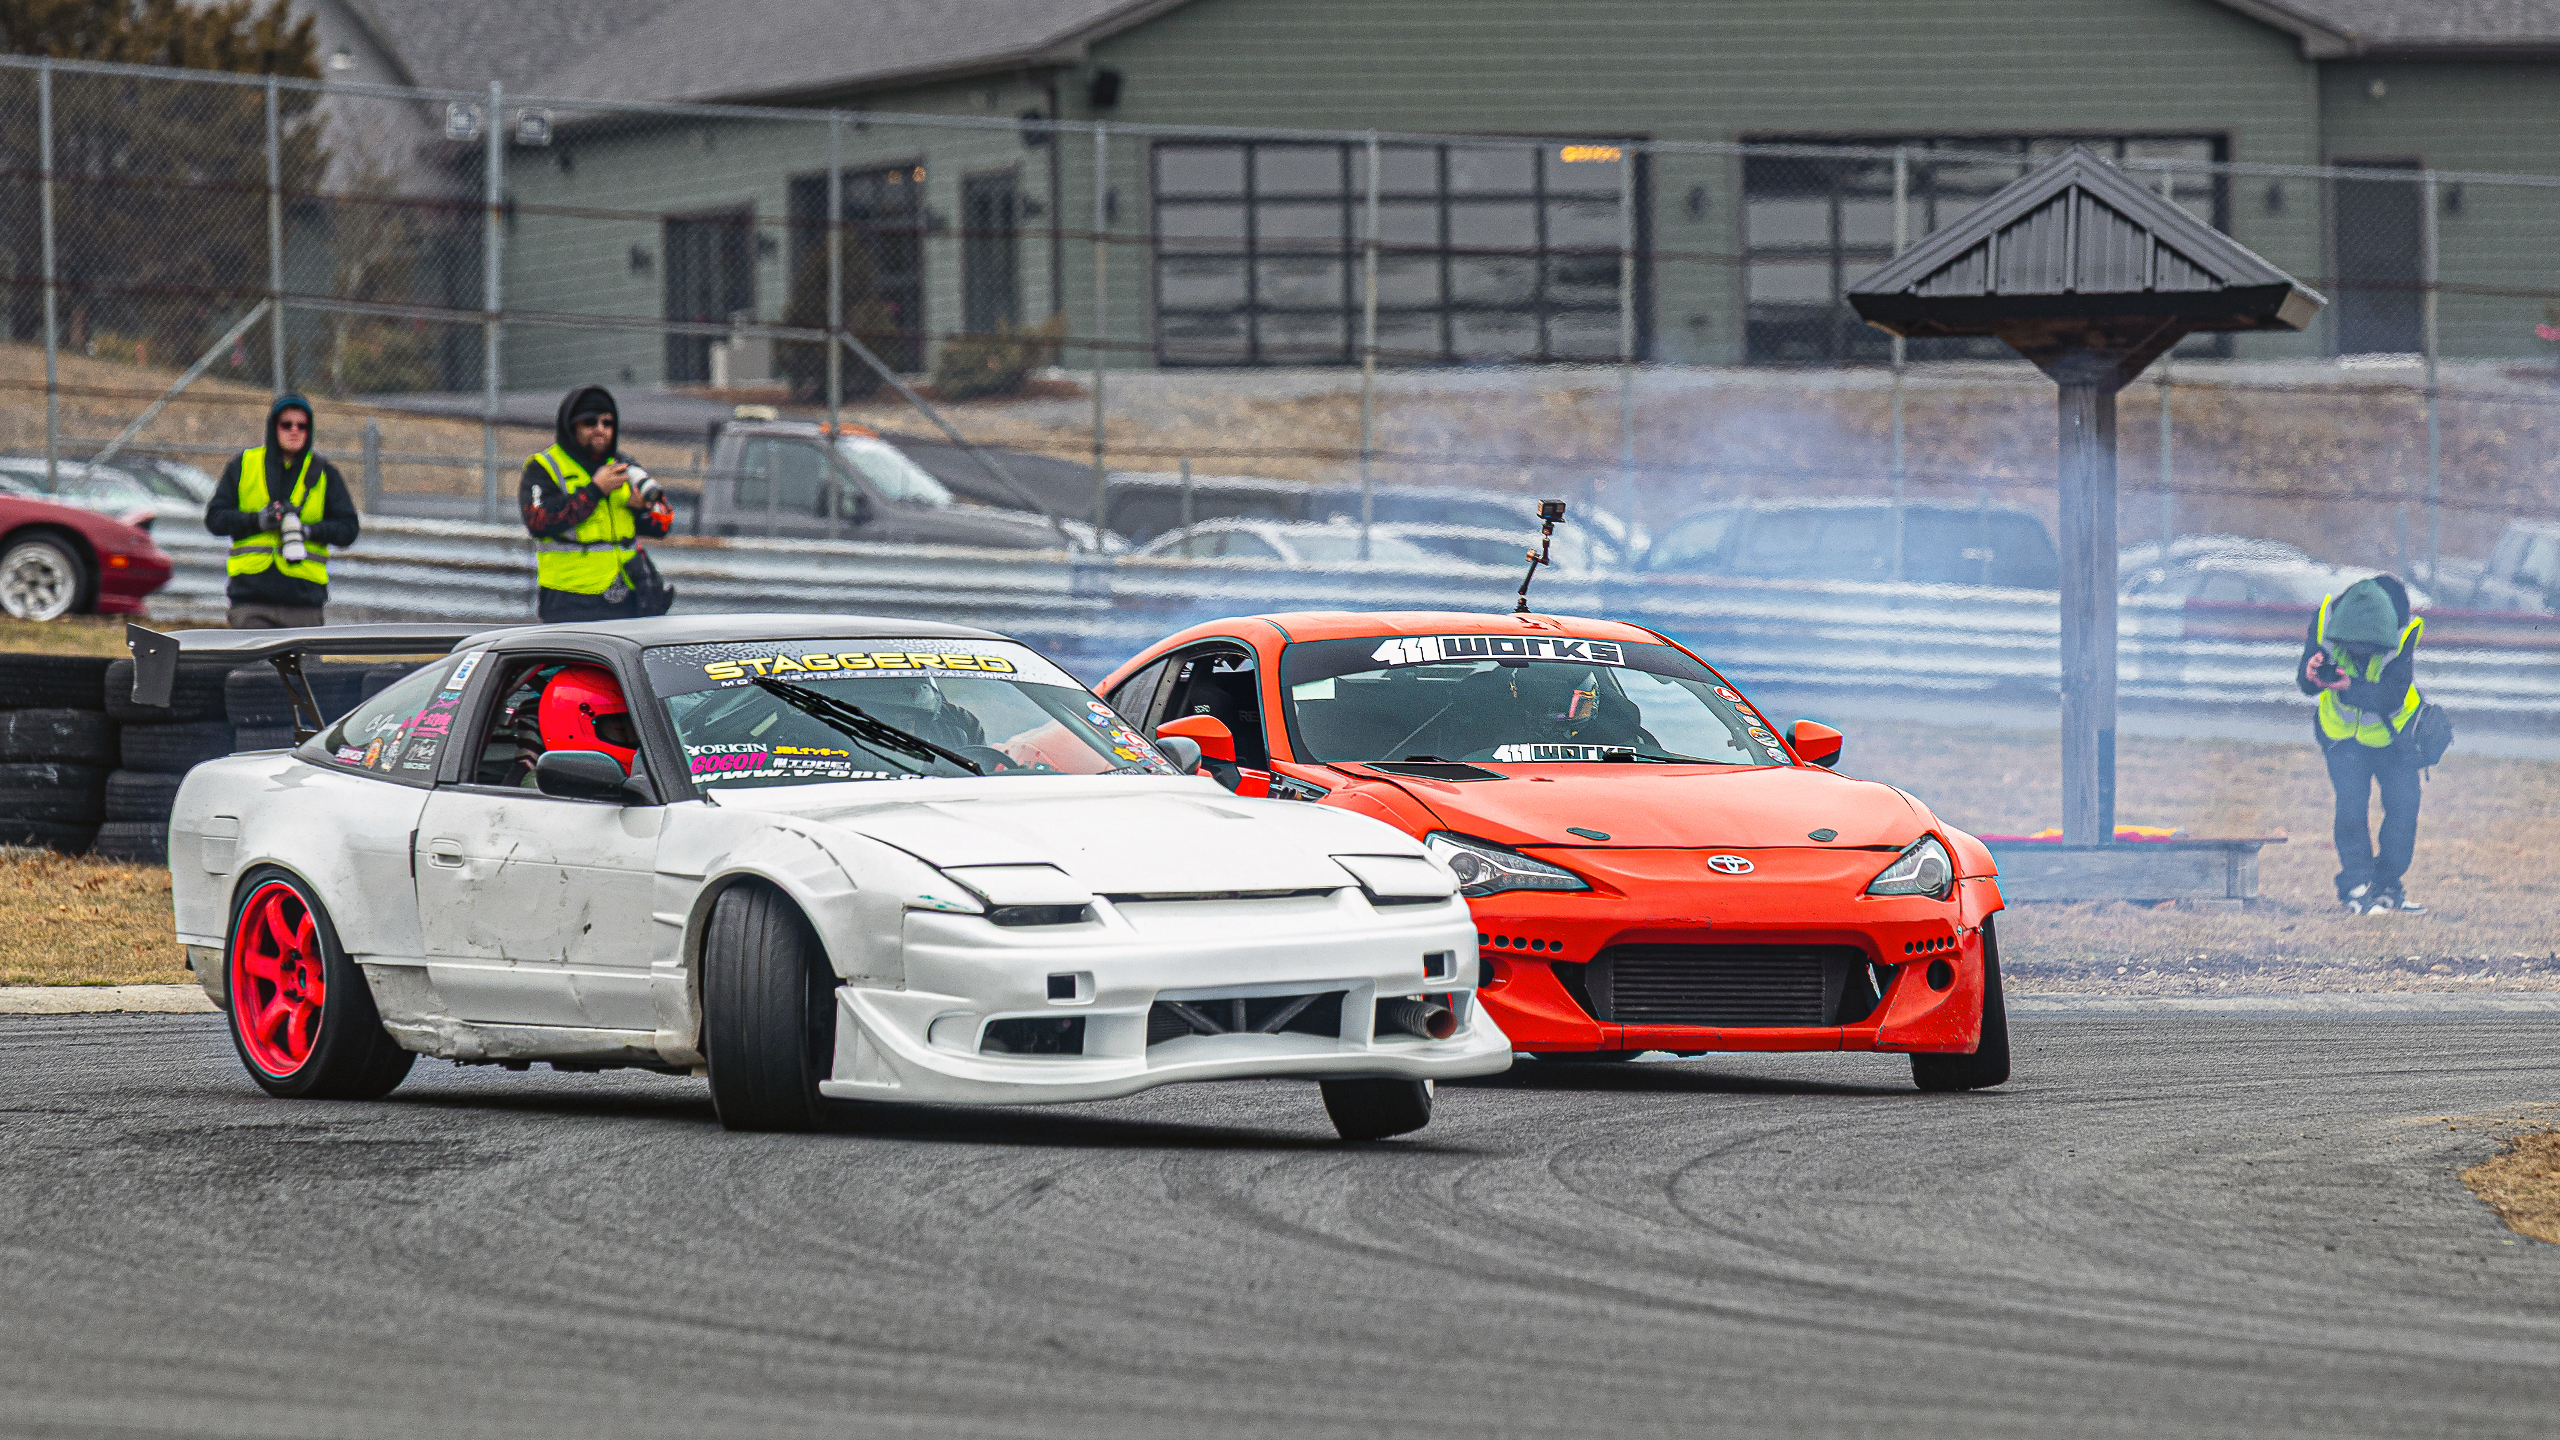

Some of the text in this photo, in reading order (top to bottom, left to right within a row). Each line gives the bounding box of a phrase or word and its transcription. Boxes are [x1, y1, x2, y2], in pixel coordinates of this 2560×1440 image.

[703, 651, 1016, 681] STAGGERED
[720, 671, 868, 687] MORSPORTS
[877, 670, 967, 678] FESTIVAL
[700, 743, 768, 755] ORIGIN
[689, 752, 768, 774] GOGO!!
